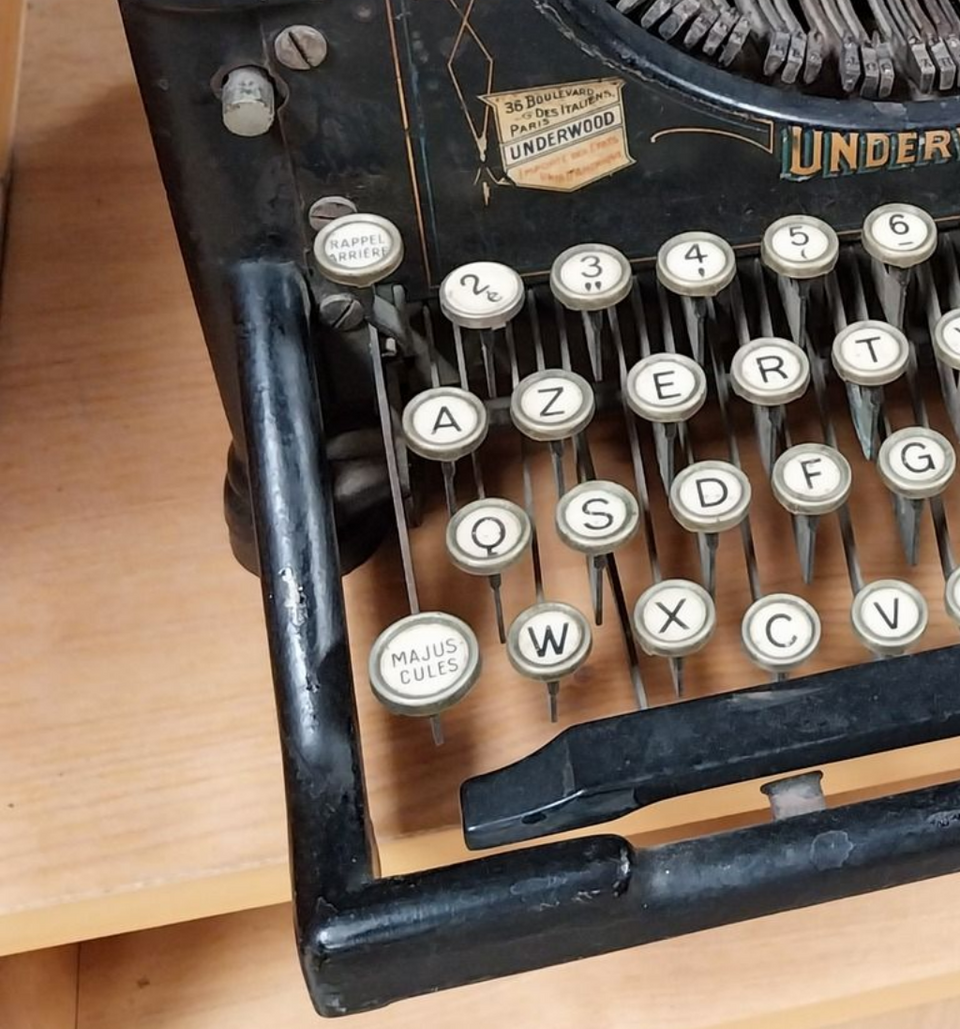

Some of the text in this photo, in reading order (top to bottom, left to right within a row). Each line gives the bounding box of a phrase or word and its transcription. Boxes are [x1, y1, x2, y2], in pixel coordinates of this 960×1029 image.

[504, 87, 595, 114] 36 BOULEVARD
[535, 106, 559, 119] DES
[510, 118, 551, 137] PARIS
[510, 111, 616, 161] UNDERWOOD
[788, 225, 810, 246] 5
[888, 213, 910, 235] 6
[330, 234, 385, 250] RAPPEL
[683, 242, 708, 264] 4
[581, 255, 603, 279] 3
[460, 274, 491, 296] 2
[855, 336, 881, 363] T
[755, 355, 789, 384] R
[652, 370, 682, 400] E
[537, 386, 565, 417] Z
[432, 406, 462, 435] A
[901, 441, 936, 473] G
[800, 457, 822, 490] F
[695, 477, 729, 508] D
[581, 497, 614, 531] S
[470, 516, 507, 556] Q
[655, 598, 690, 634] X
[873, 598, 899, 630] V
[527, 621, 570, 658] W
[765, 613, 798, 648] C
[391, 637, 458, 668] MAJUS
[400, 657, 459, 685] CULES
